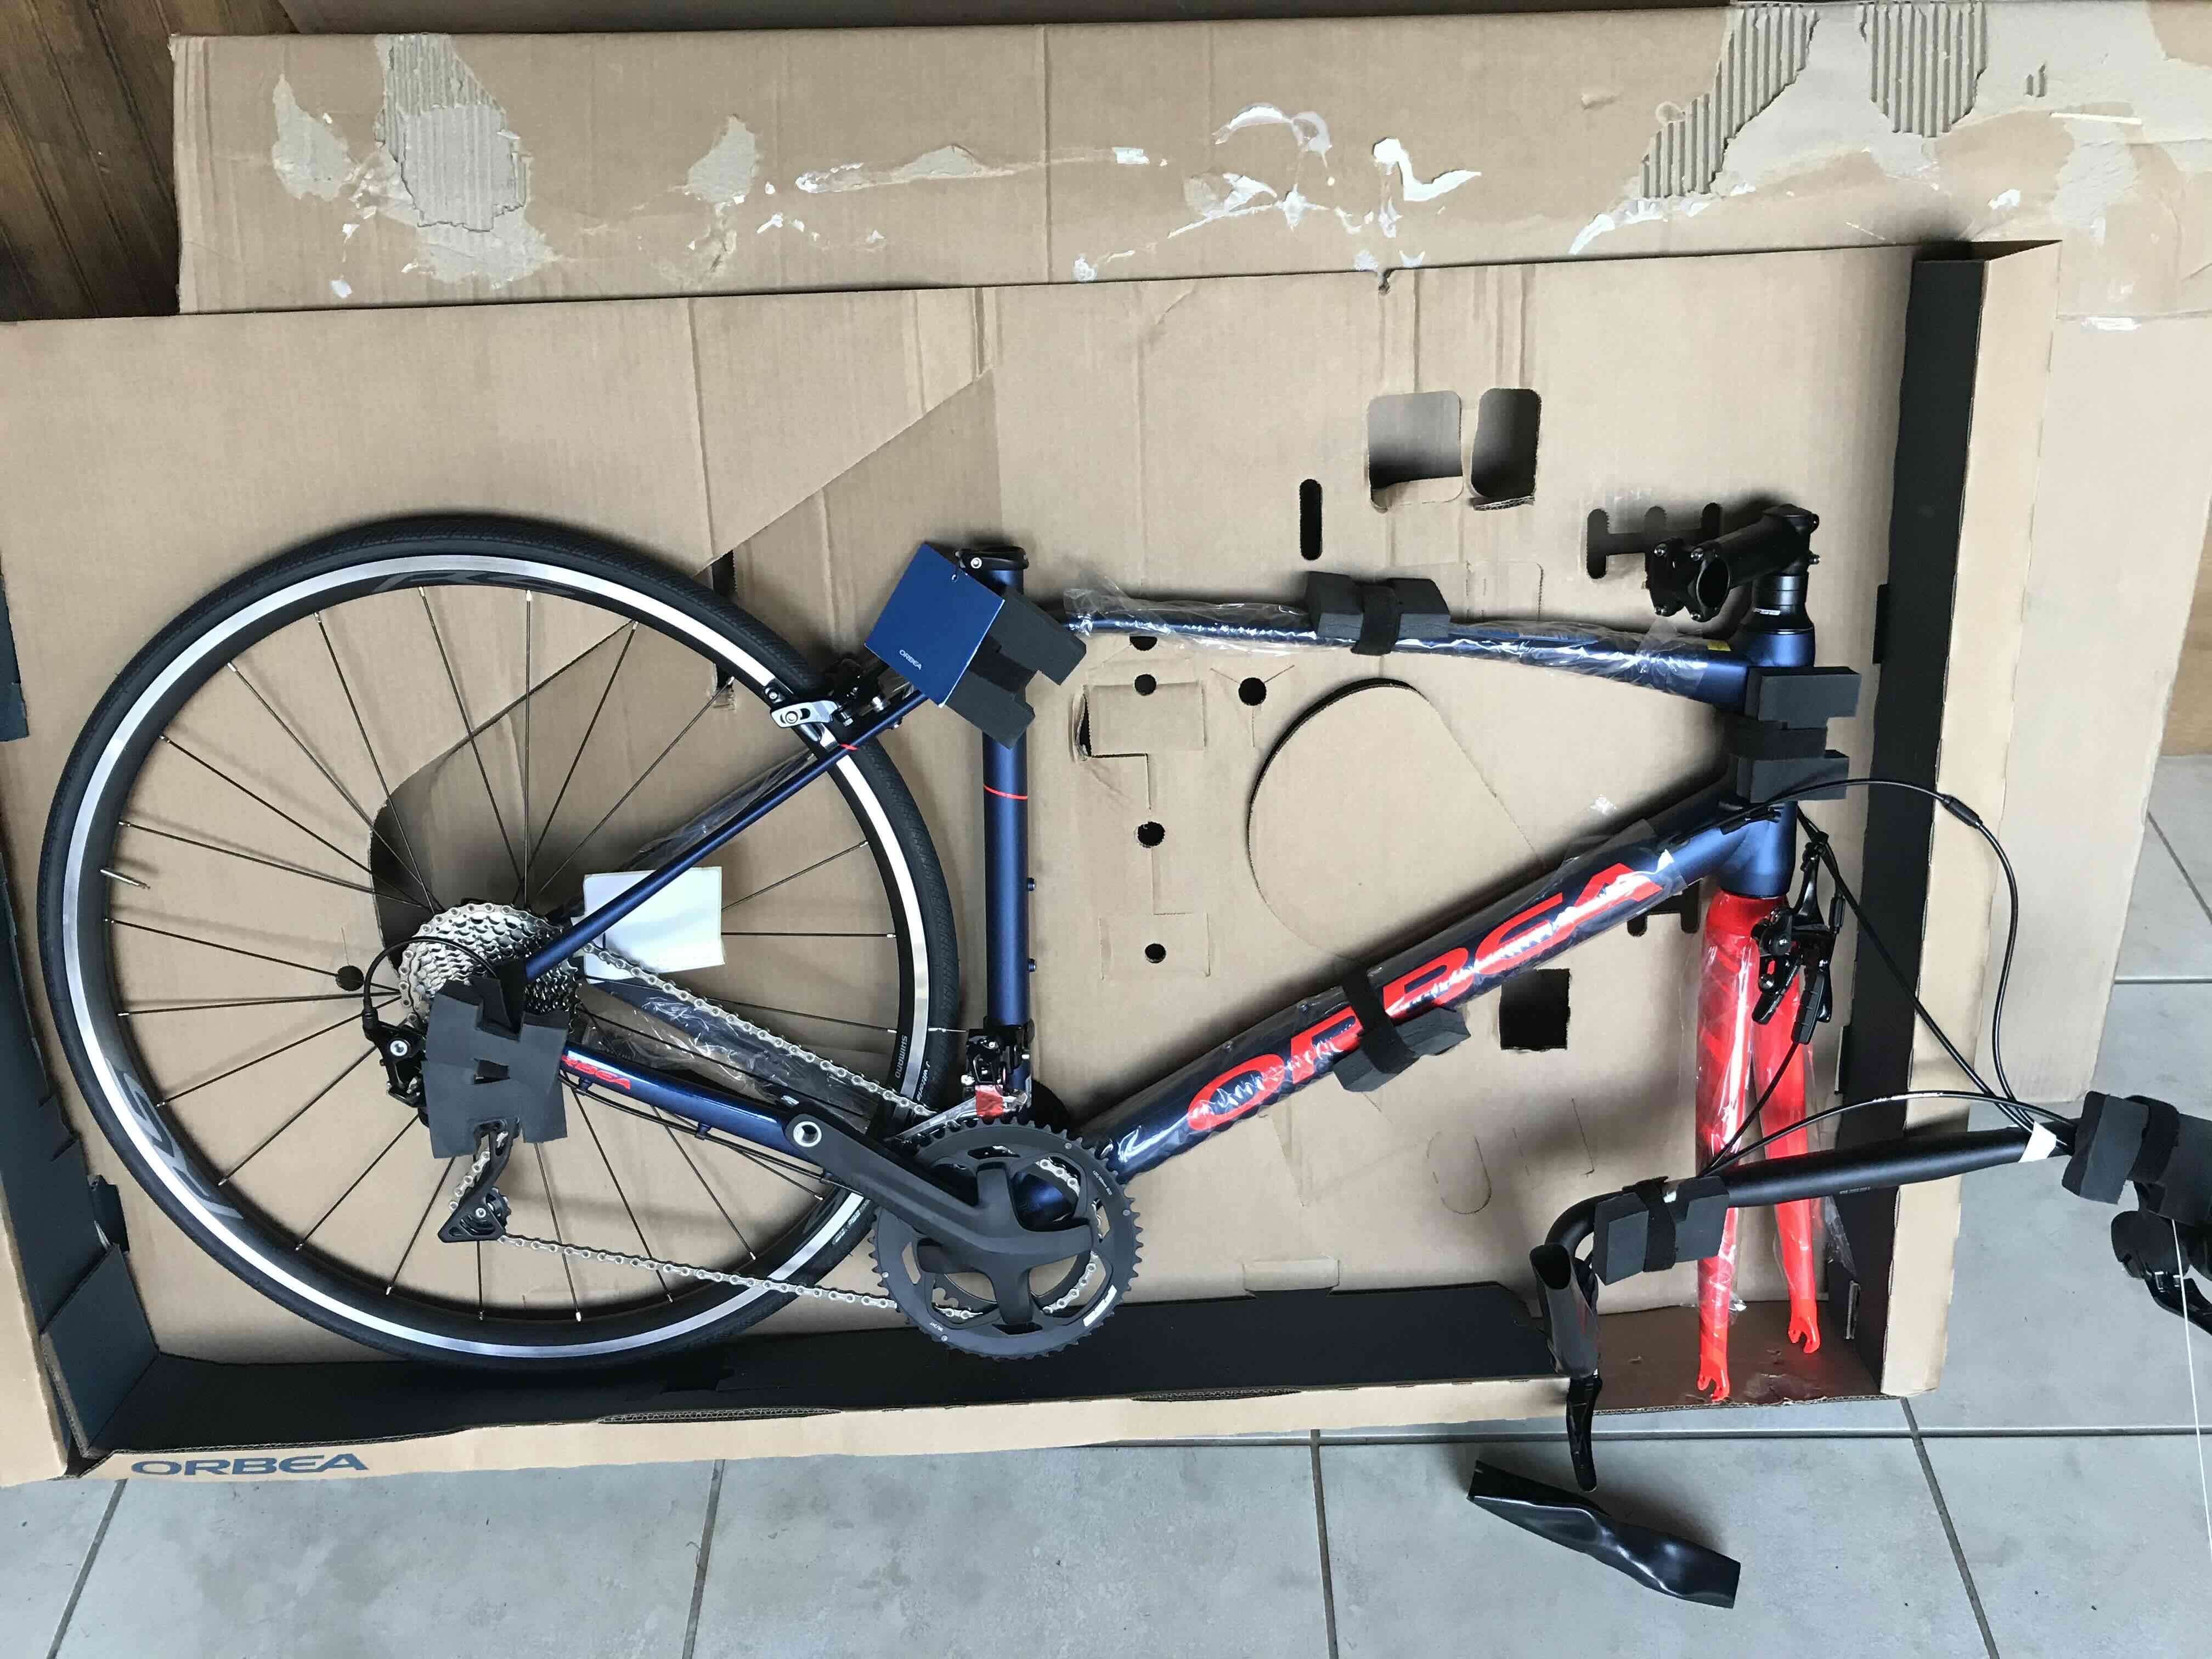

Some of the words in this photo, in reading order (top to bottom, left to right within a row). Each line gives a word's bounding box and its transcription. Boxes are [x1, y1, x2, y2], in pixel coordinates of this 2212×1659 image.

[900, 650, 922, 670] ORBEA
[1188, 862, 1662, 1131] ORBEA
[561, 1054, 630, 1090] RBEA
[895, 1035, 908, 1079] SHIMANO
[131, 1453, 369, 1475] ORBEA
